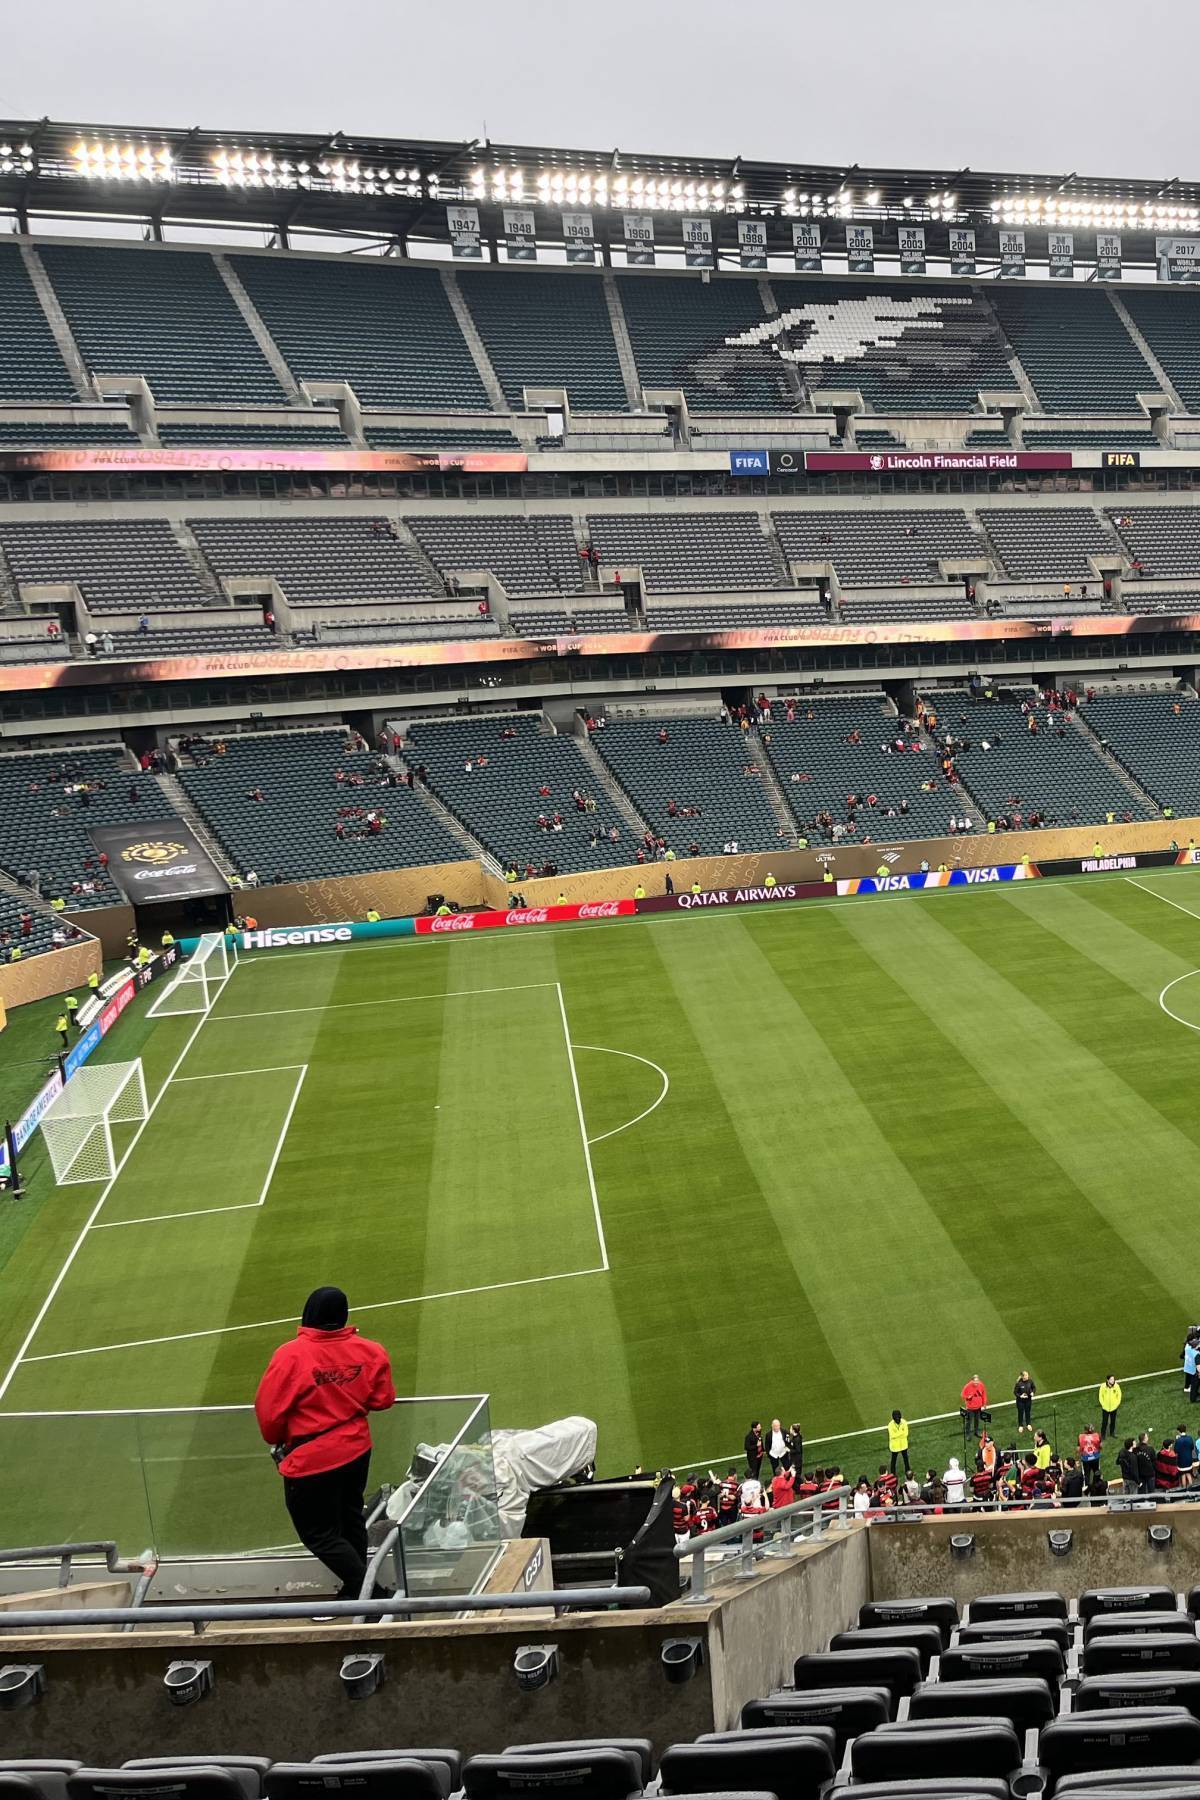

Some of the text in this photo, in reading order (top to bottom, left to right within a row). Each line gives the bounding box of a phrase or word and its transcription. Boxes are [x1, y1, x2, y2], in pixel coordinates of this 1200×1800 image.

[452, 220, 476, 231] 1947
[508, 223, 532, 234] 1948
[567, 226, 590, 237] 1949
[687, 231, 709, 242] 1980
[742, 233, 763, 244] 1988
[796, 235, 818, 246] 2001
[849, 239, 871, 248] 2002
[901, 240, 923, 249] 2003
[951, 241, 973, 250] 2004
[1175, 245, 1195, 255] 2017
[1100, 246, 1119, 256] 2013
[735, 458, 762, 468] FIFA
[887, 456, 1018, 468] Lincoln Financial Field
[1107, 454, 1135, 466] FIFA
[1081, 856, 1136, 872] PHILADELPHIA
[134, 864, 197, 879] Coca-Cola
[964, 868, 1000, 884] VISA
[871, 875, 910, 891] VISA
[678, 885, 796, 908] QATAR AIRWAYS
[578, 902, 619, 917] Coca-Cola
[506, 909, 548, 925] Coca-Cola
[431, 914, 475, 932] Coca-Cola
[243, 926, 351, 949] Hisense
[526, 1546, 542, 1586] C37
